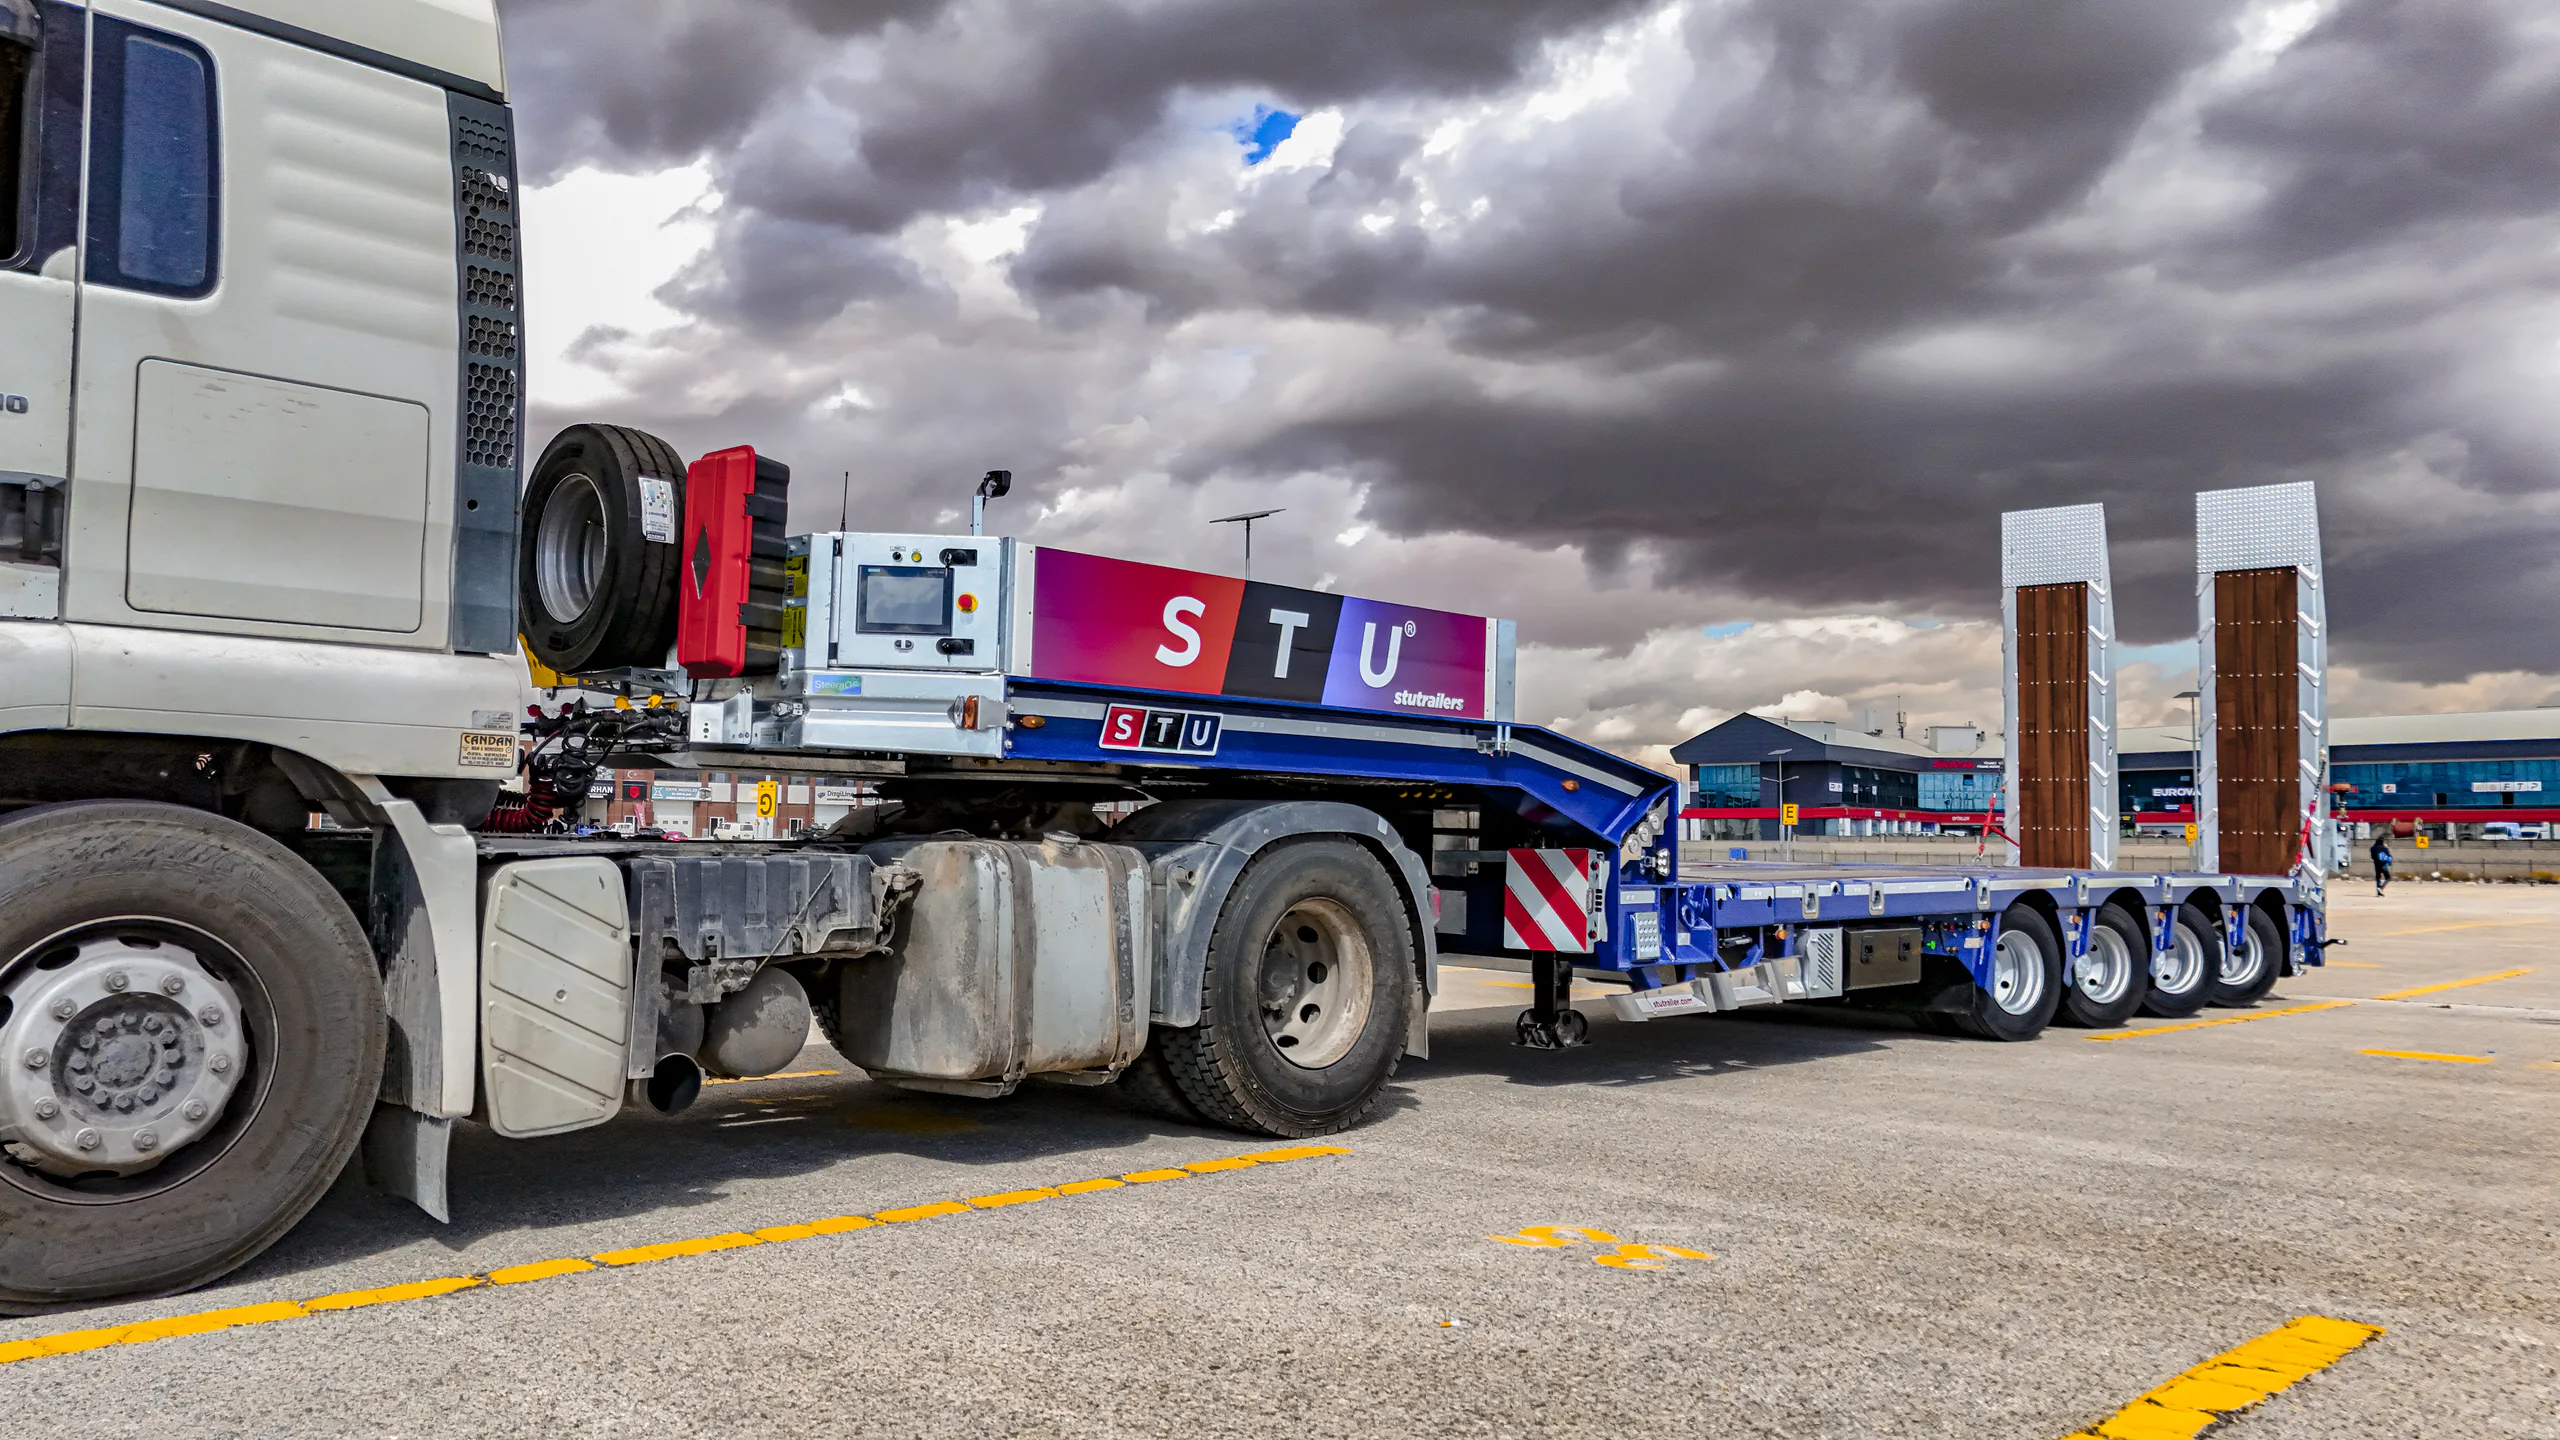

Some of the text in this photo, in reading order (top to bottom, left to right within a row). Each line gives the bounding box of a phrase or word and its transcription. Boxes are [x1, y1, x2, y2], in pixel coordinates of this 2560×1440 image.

[1393, 690, 1464, 711] stutrailers
[1114, 714, 1211, 746] STU
[464, 735, 513, 746] CANDAN
[760, 793, 772, 815] G
[1786, 806, 1794, 818] E
[2188, 825, 2195, 834] C
[1652, 998, 1693, 1008] stutrailer.com
